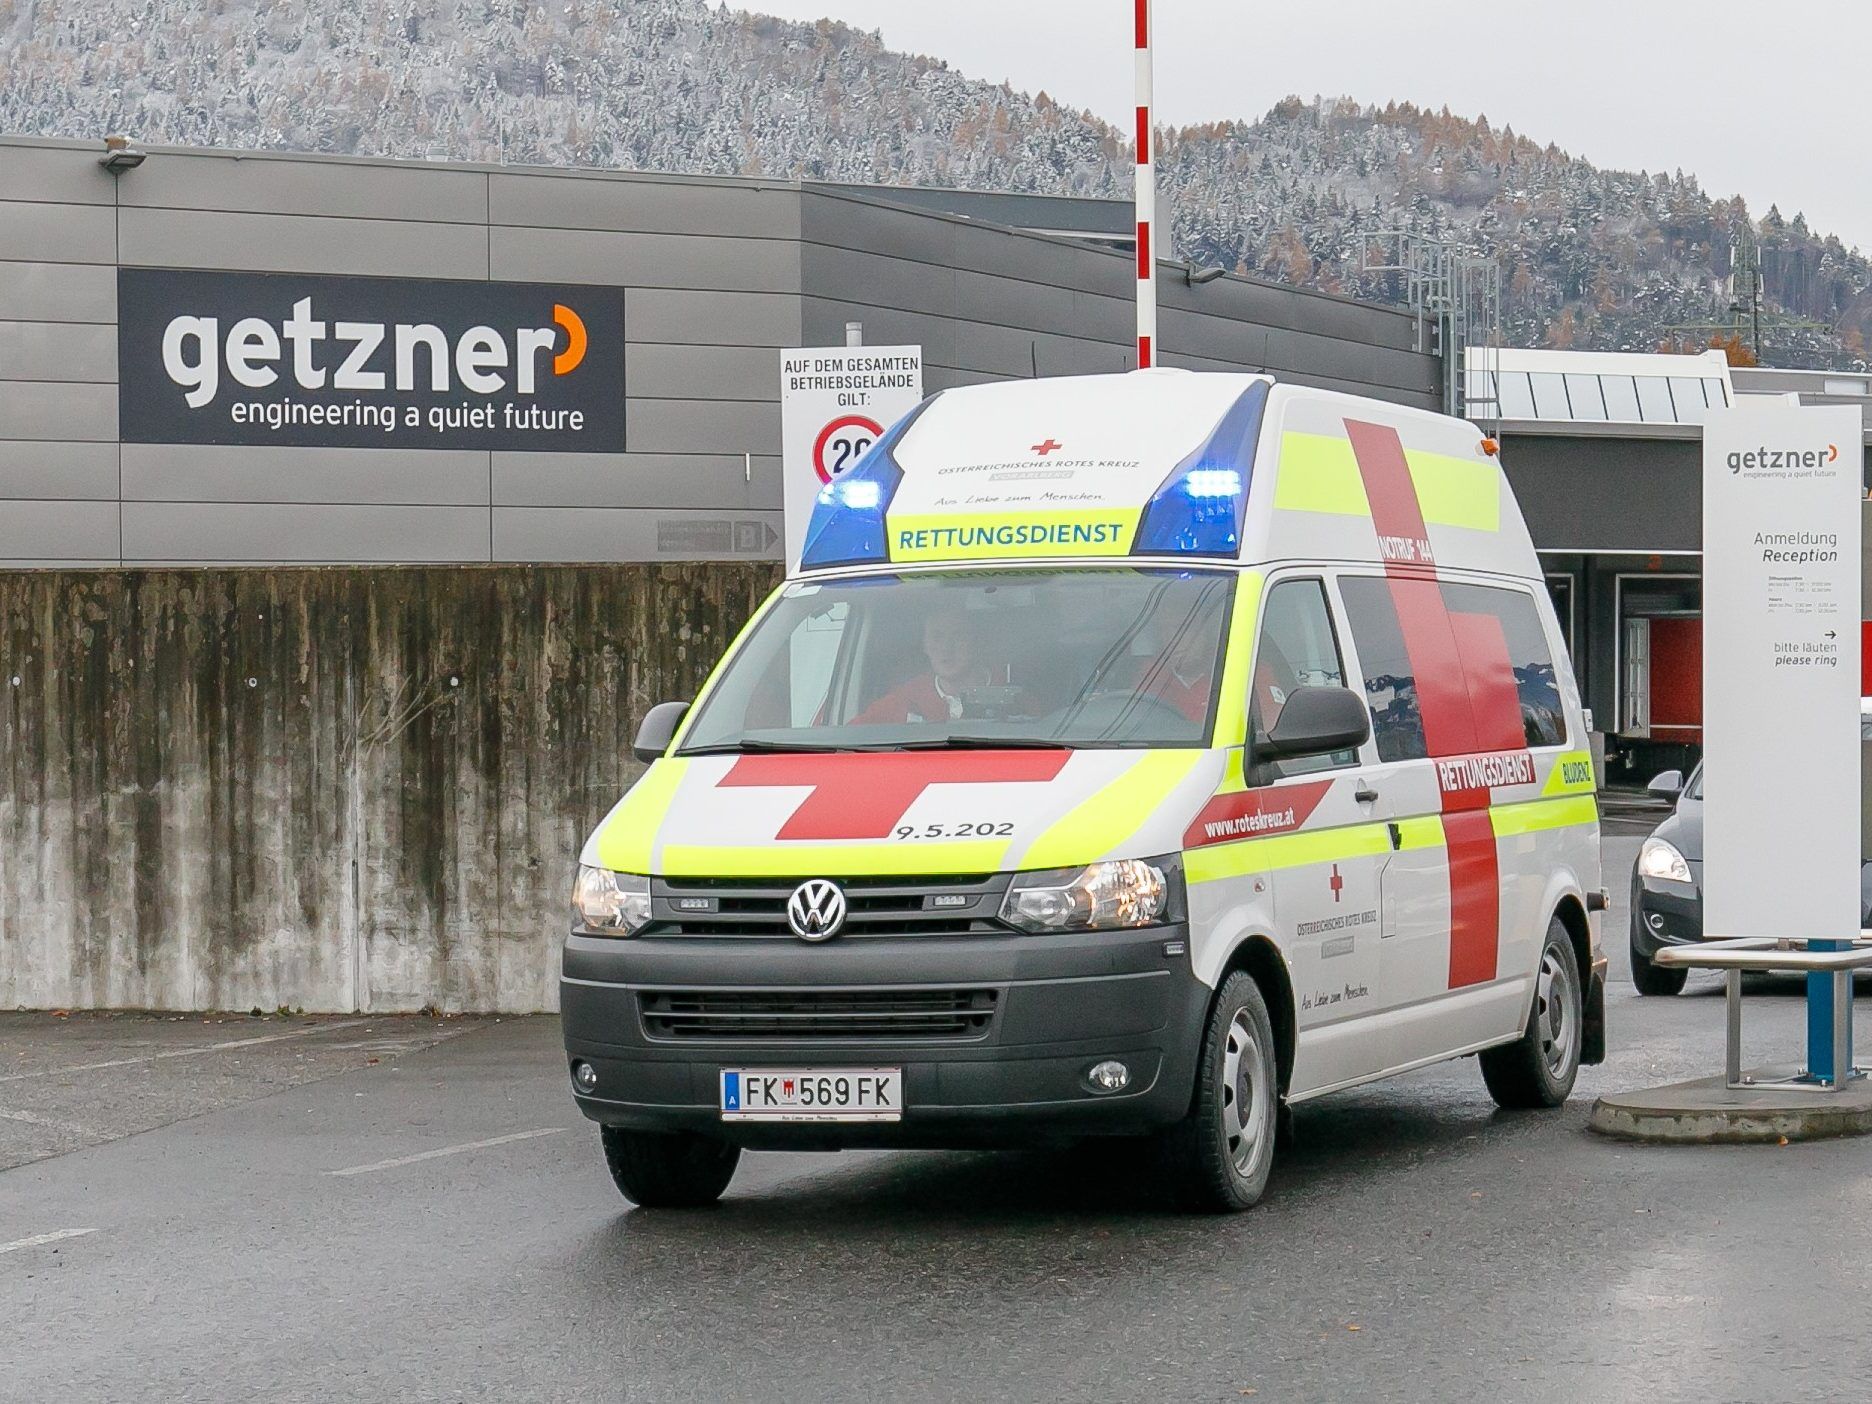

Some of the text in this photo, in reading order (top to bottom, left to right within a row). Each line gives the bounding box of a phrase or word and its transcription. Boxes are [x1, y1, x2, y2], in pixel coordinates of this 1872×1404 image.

[161, 296, 556, 409] getzner
[785, 357, 919, 373] AUF DEM GESAMTEN
[790, 372, 914, 390] BETRIEBSGELÄNDE
[837, 393, 871, 407] GILT:
[231, 399, 584, 432] engineering a quiet future
[1055, 460, 1094, 468] ROTES
[1098, 460, 1141, 468] KREUZ
[1726, 446, 1829, 475] getzner
[933, 497, 958, 506] Aus
[965, 495, 1000, 504] Liebe
[900, 523, 1124, 550] RETTUNGSDIENST
[1754, 532, 1837, 547] Anmeldung
[1378, 535, 1415, 560] NOTRUF
[1762, 549, 1838, 564] Reception
[1774, 642, 1837, 653] bitte läuten
[1775, 655, 1837, 667] please ring
[1438, 753, 1533, 792] RETTUNGSDIENST
[1562, 760, 1591, 784] BLUDENZ
[896, 822, 1015, 840] 9.5.202
[1204, 806, 1296, 838] www.roteskreuz.at
[728, 1096, 736, 1105] A
[746, 1078, 890, 1106] FK 569 FK
